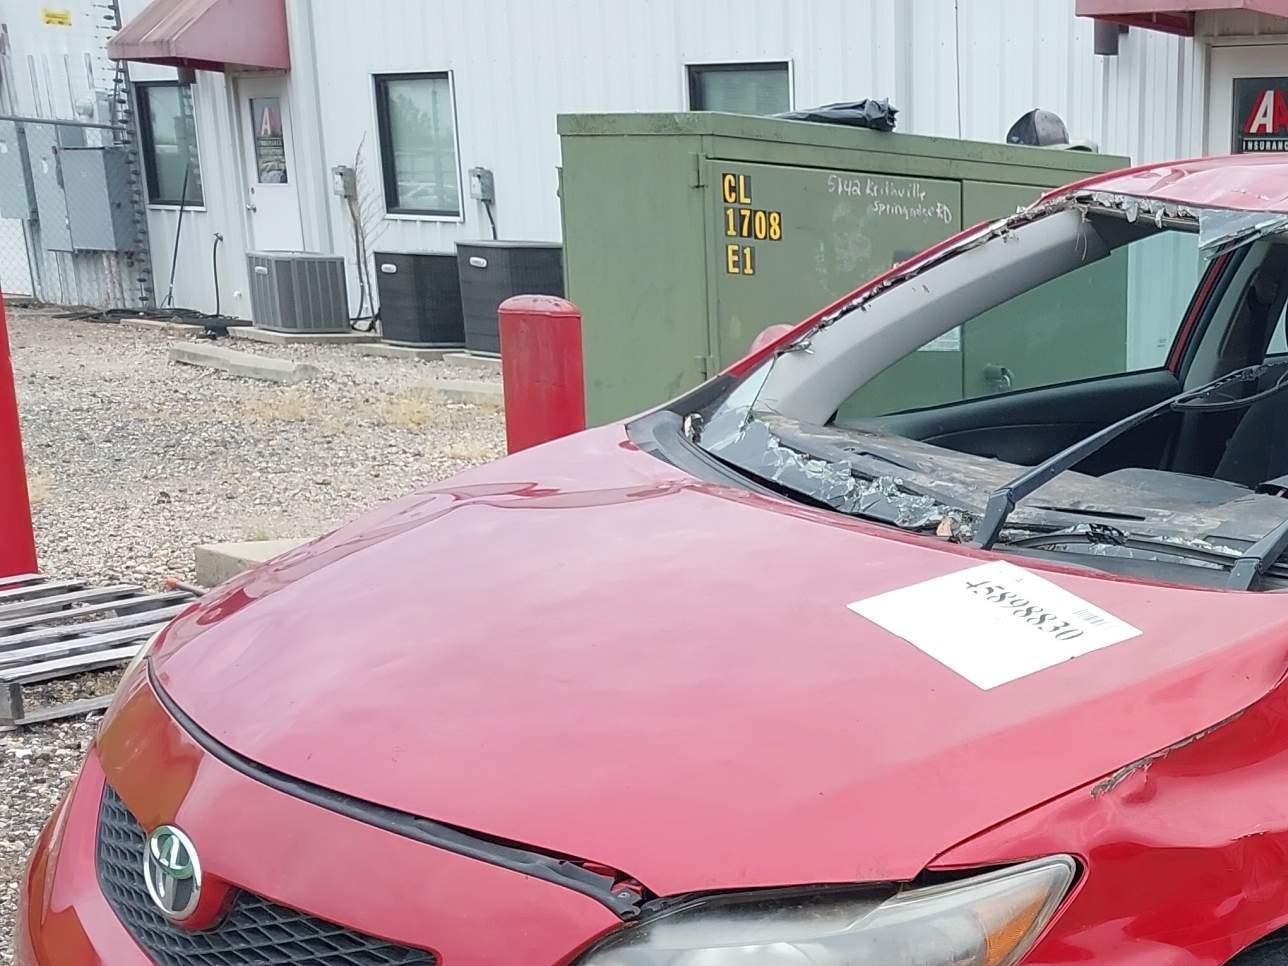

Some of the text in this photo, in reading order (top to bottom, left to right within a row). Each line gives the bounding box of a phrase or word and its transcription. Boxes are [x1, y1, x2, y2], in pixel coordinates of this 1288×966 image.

[723, 174, 752, 204] CL
[827, 174, 861, 196] 5142
[726, 207, 782, 241] 1708
[727, 244, 754, 275] E1
[964, 578, 1085, 641] 45898830
